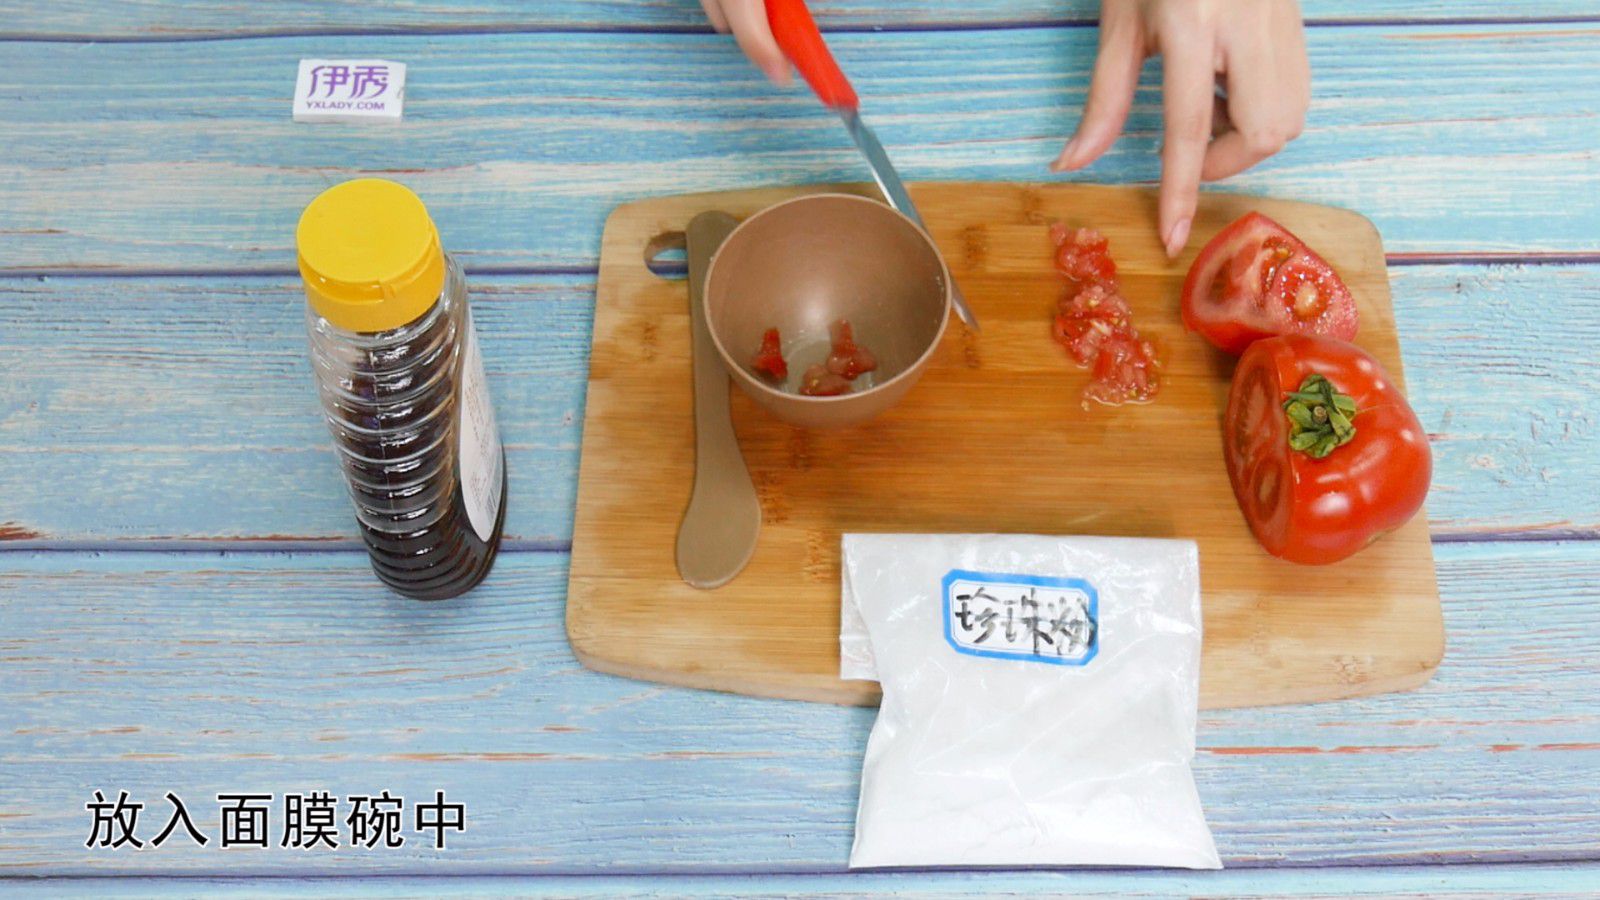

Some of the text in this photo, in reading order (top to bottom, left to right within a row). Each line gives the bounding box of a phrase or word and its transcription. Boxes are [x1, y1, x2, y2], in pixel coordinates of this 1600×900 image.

[306, 65, 389, 99] 伊秀
[306, 101, 385, 111] YXLADY.COM
[954, 586, 1098, 657] 珍珠粉
